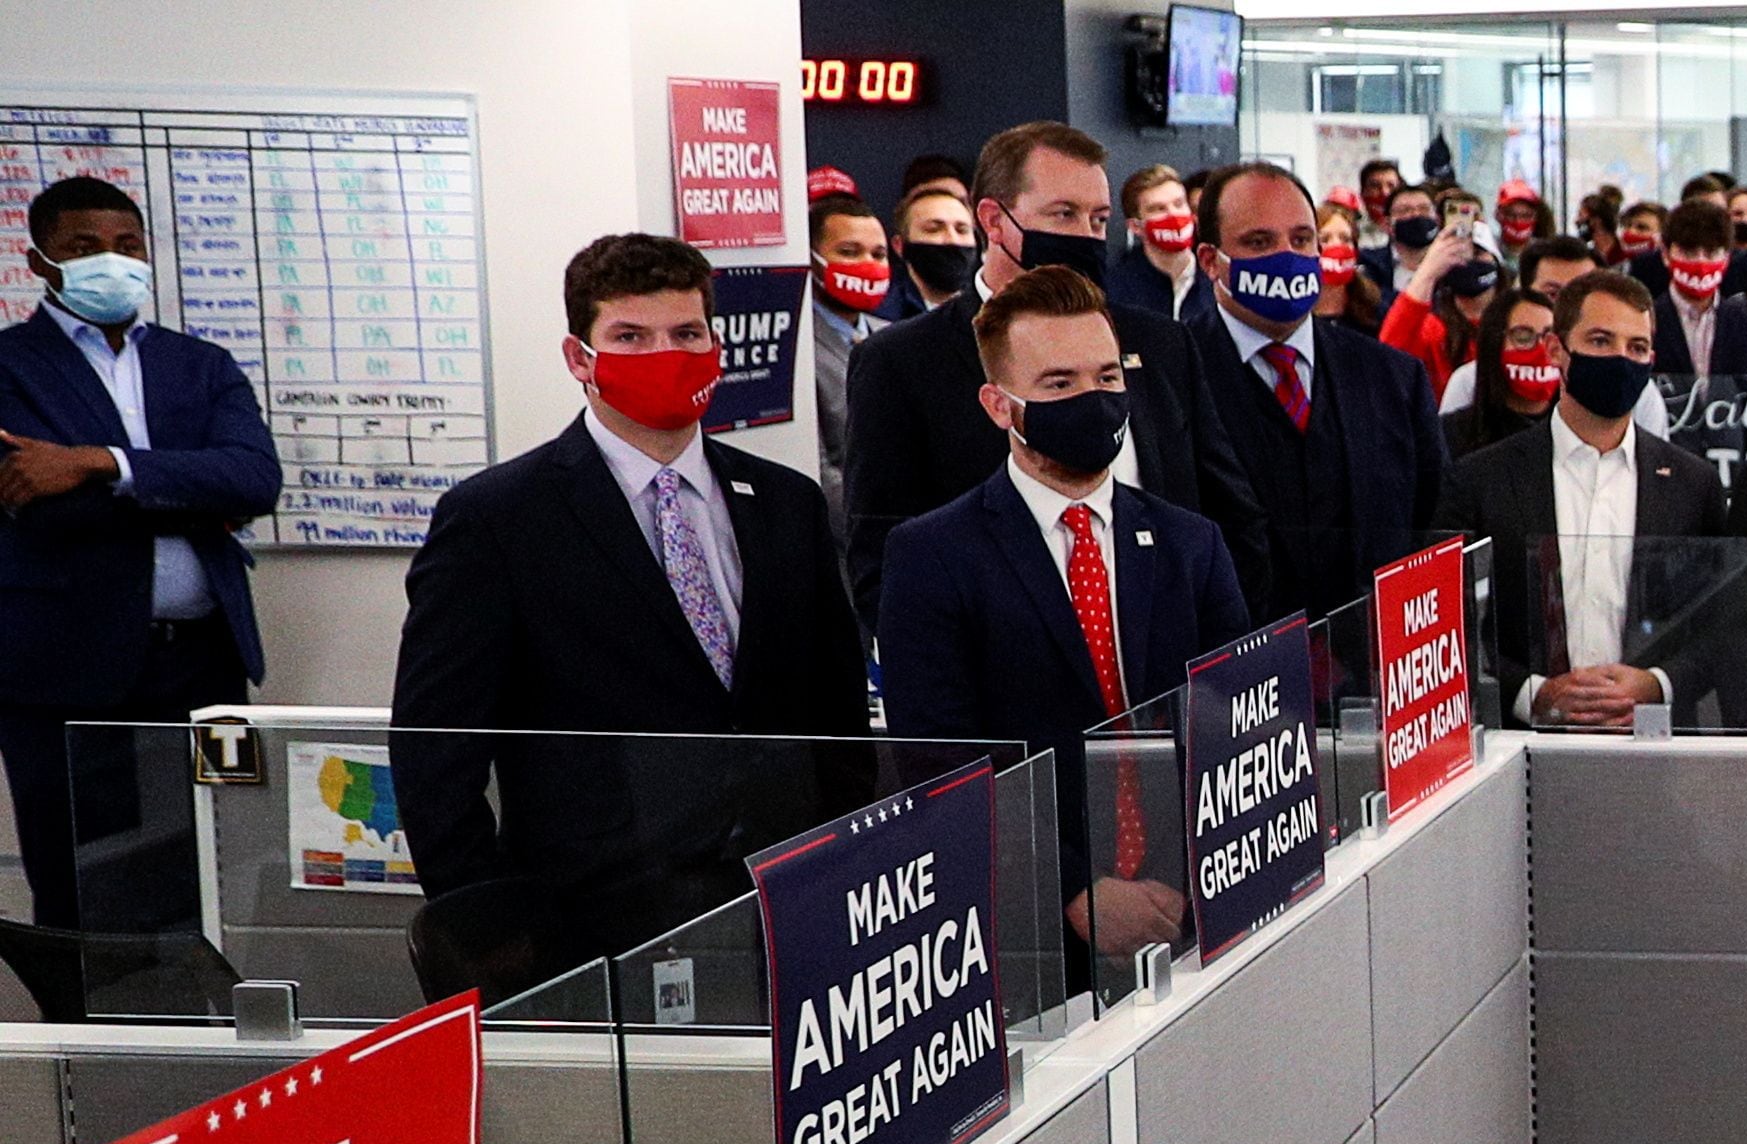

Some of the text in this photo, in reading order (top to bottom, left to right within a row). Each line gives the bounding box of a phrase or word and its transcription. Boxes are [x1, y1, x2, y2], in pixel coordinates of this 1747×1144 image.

[702, 107, 747, 134] MAKE
[681, 142, 778, 179] AMERICA
[683, 188, 779, 215] GREAT AGAIN
[1237, 270, 1320, 300] MAGA
[1672, 267, 1722, 291] MAGA
[435, 327, 468, 344] OH
[711, 311, 791, 344] RUMP
[719, 344, 779, 368] ENCE
[1403, 588, 1439, 638] MAKE
[1387, 628, 1463, 717] AMERICA
[1232, 675, 1280, 738] MAKE
[1388, 690, 1467, 770] GREAT AGAIN
[1196, 722, 1313, 838] AMERICA
[1200, 795, 1319, 900] GREAT AGAIN
[847, 852, 936, 946] MAKE
[790, 906, 989, 1092] AMERICA
[912, 1000, 997, 1106] AGAIN
